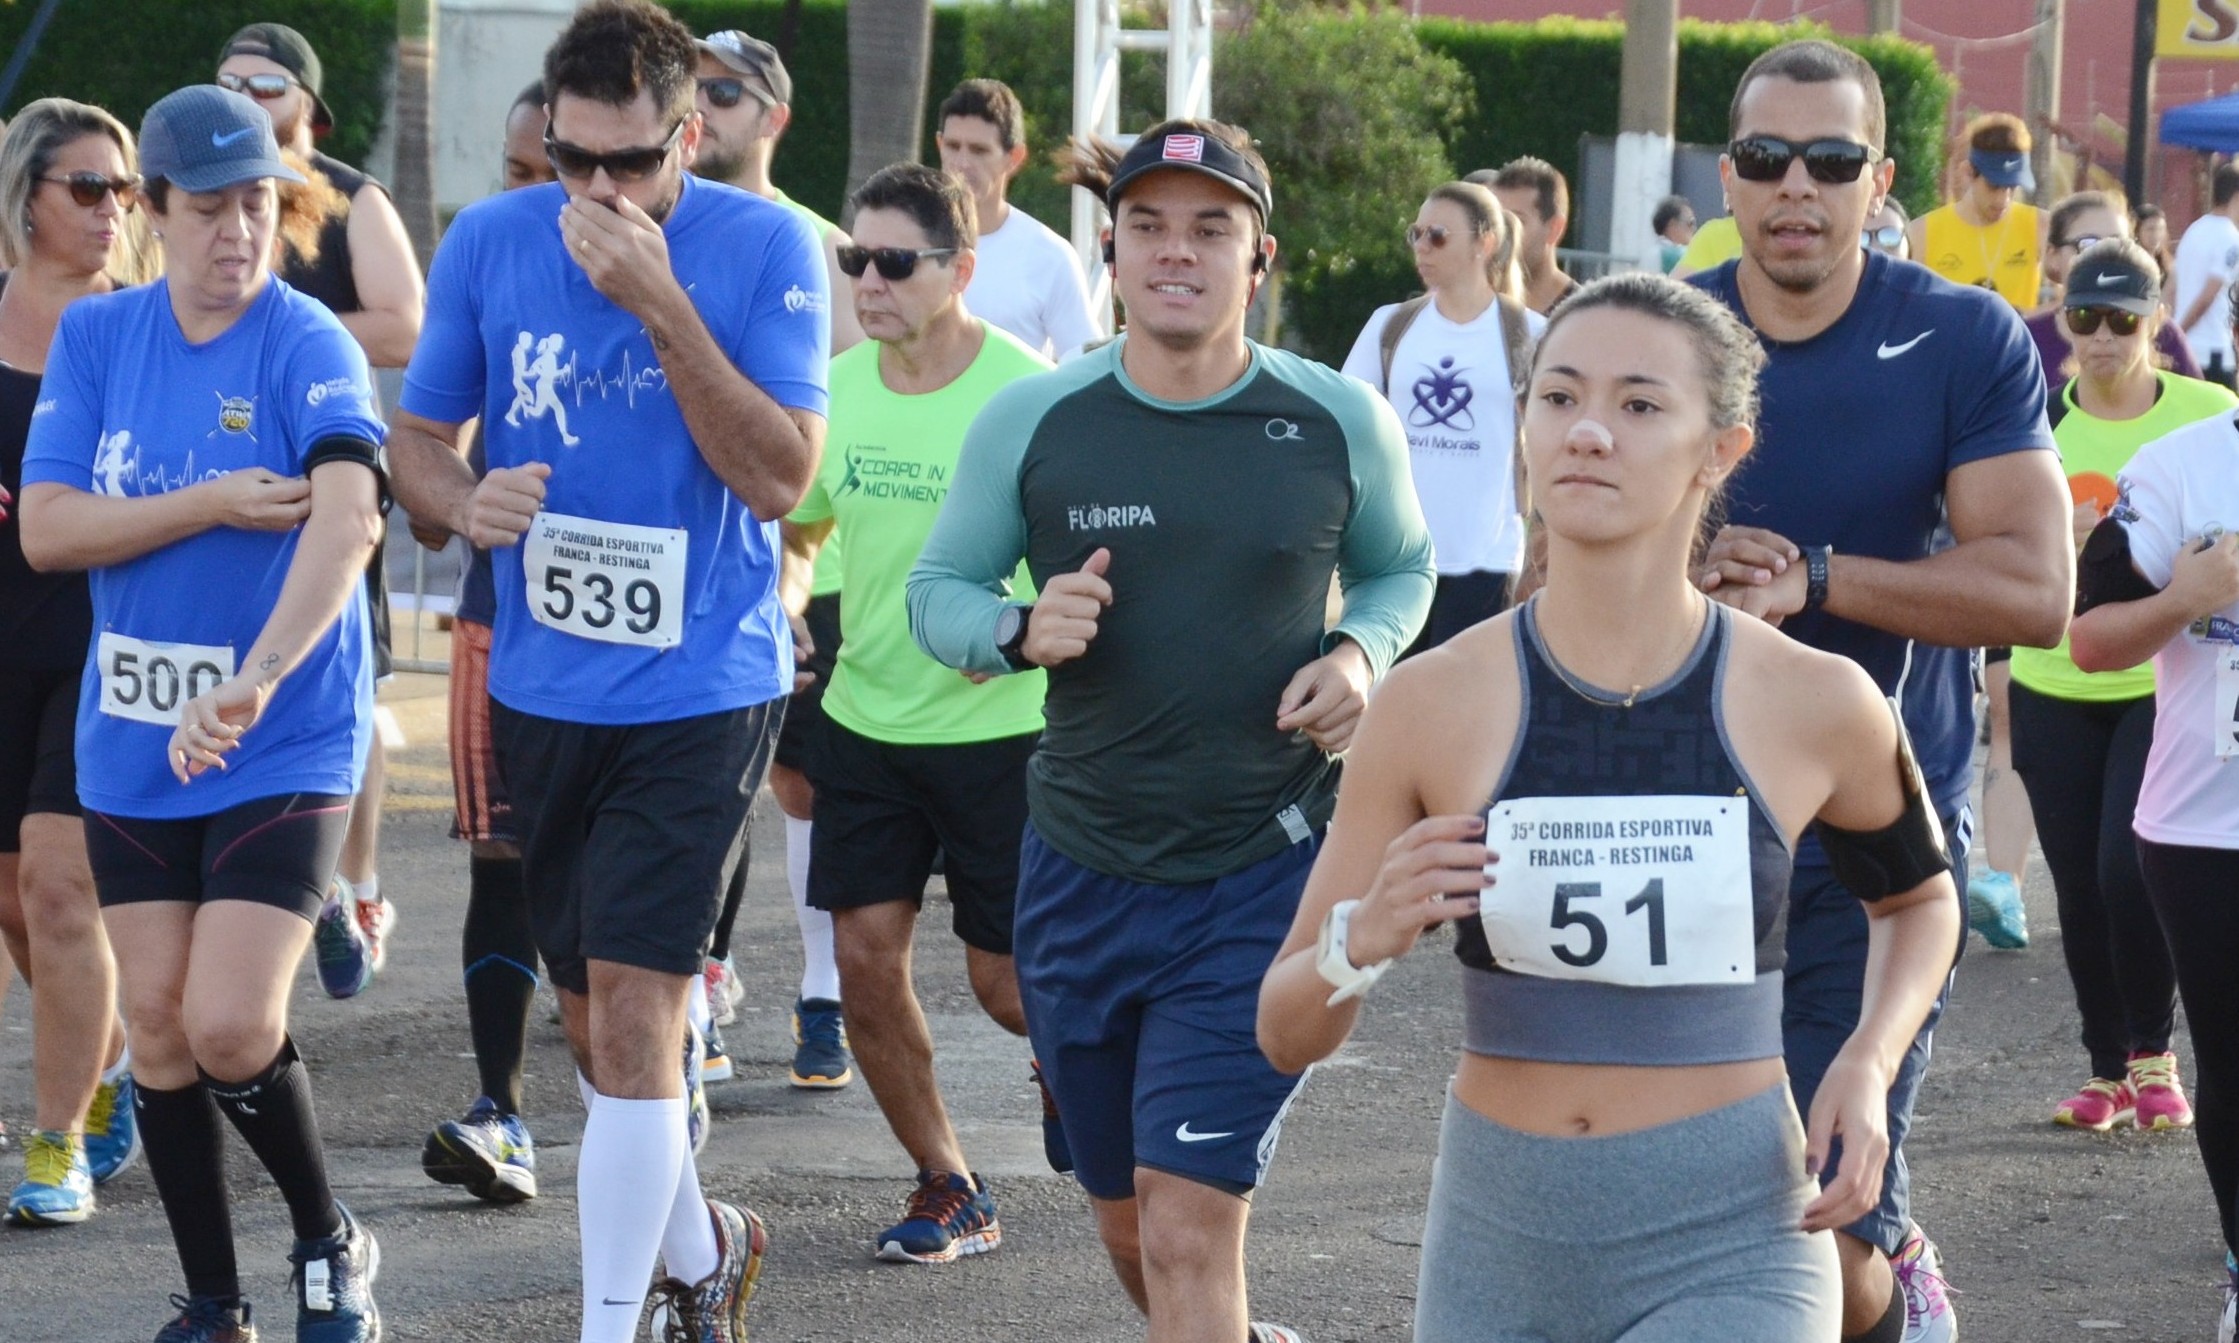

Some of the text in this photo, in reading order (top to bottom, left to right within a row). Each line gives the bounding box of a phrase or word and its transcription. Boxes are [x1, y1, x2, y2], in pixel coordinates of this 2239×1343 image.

[1432, 436, 1481, 451] Morais
[927, 464, 946, 481] IN
[1068, 504, 1156, 531] FLORIPA
[561, 529, 604, 548] CORRIDA
[606, 537, 664, 555] ESPORTIVA
[553, 545, 591, 563] FRANCA
[599, 554, 651, 570] RESTINGA
[543, 564, 661, 635] 539
[112, 650, 223, 712] 500
[1511, 819, 1713, 841] 35ª CORRIDA ESPORTIVA
[1529, 848, 1595, 867] FRANCA
[1610, 845, 1694, 864] RESTINGA
[1550, 877, 1668, 967] 51
